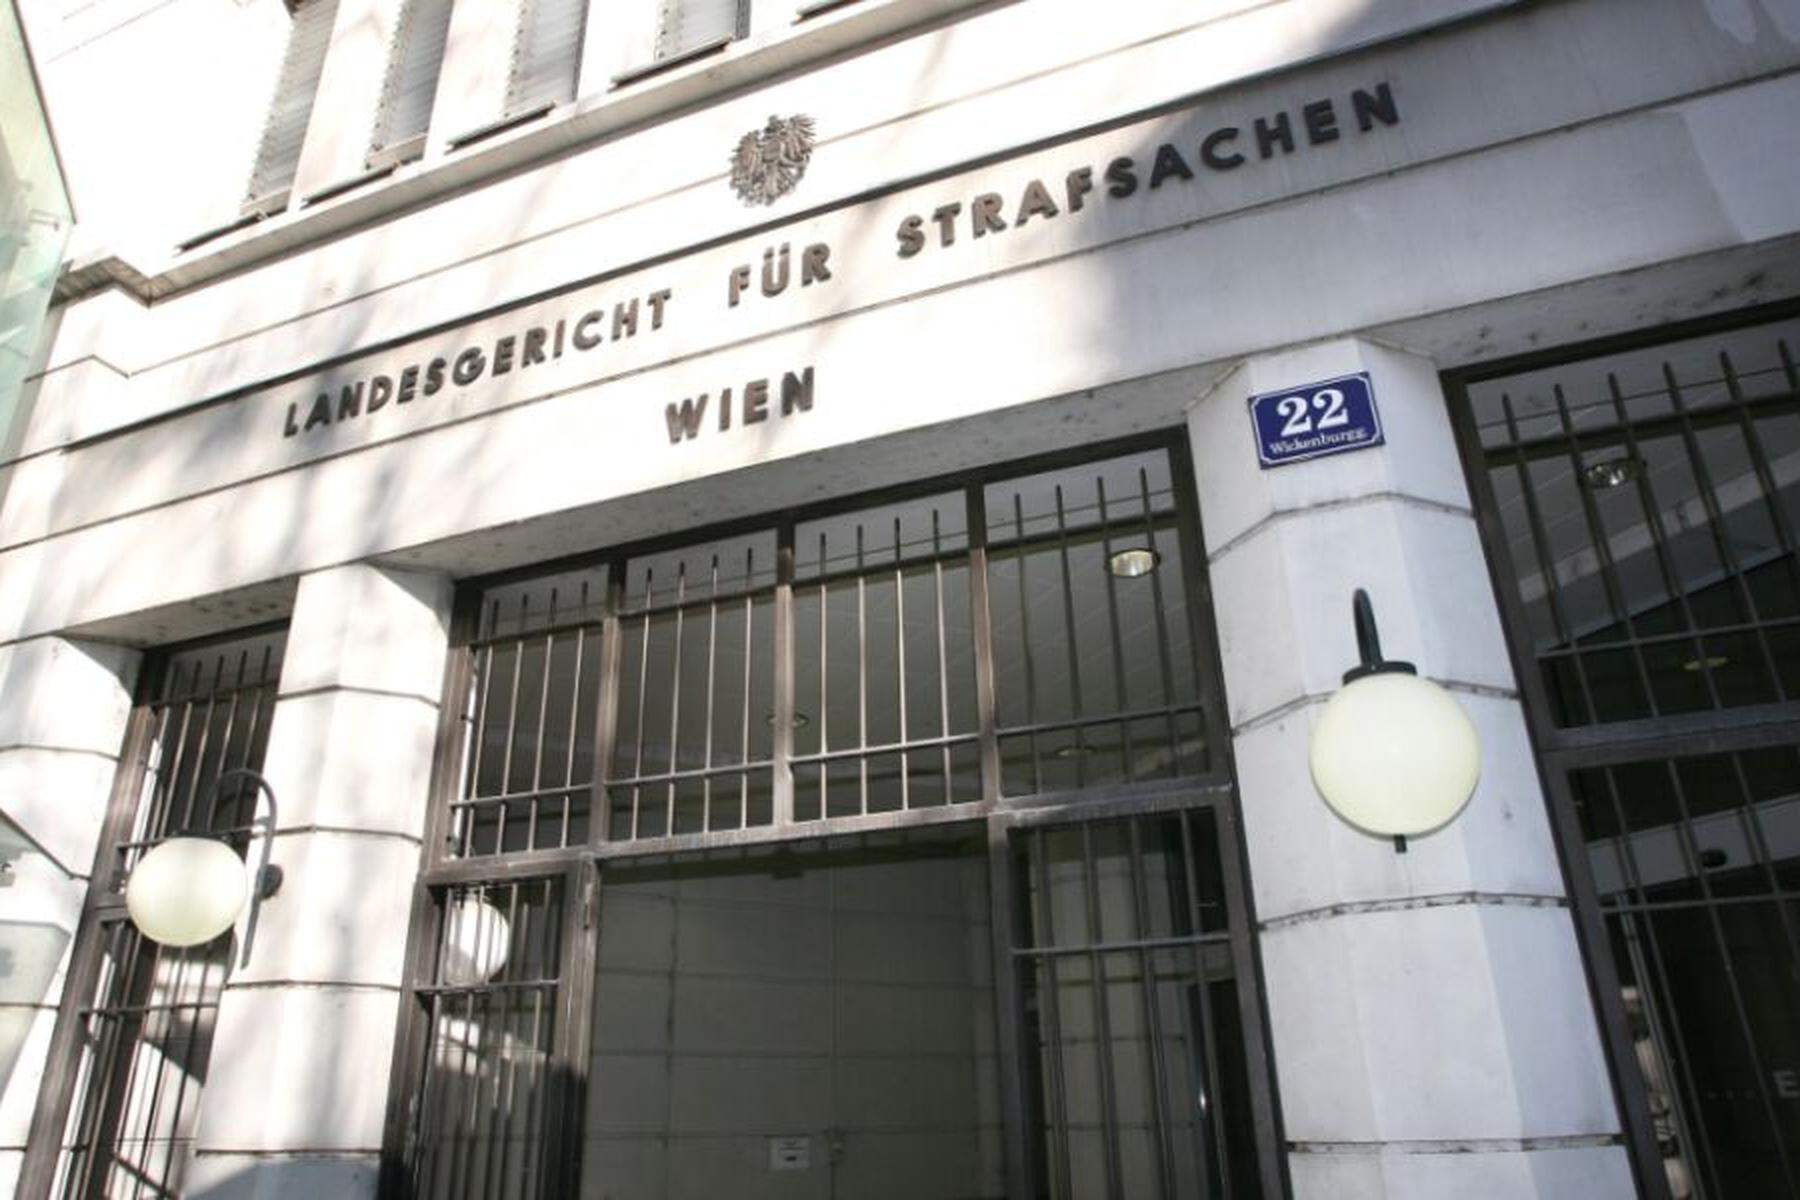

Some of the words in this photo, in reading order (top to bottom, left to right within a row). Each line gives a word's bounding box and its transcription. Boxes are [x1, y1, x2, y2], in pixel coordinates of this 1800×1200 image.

[285, 289, 673, 437] LANDESGERICHT
[729, 242, 833, 307] FÜR
[896, 83, 1399, 258] STRAFSACHEN
[666, 367, 816, 443] WIEN
[1276, 389, 1349, 437] 22
